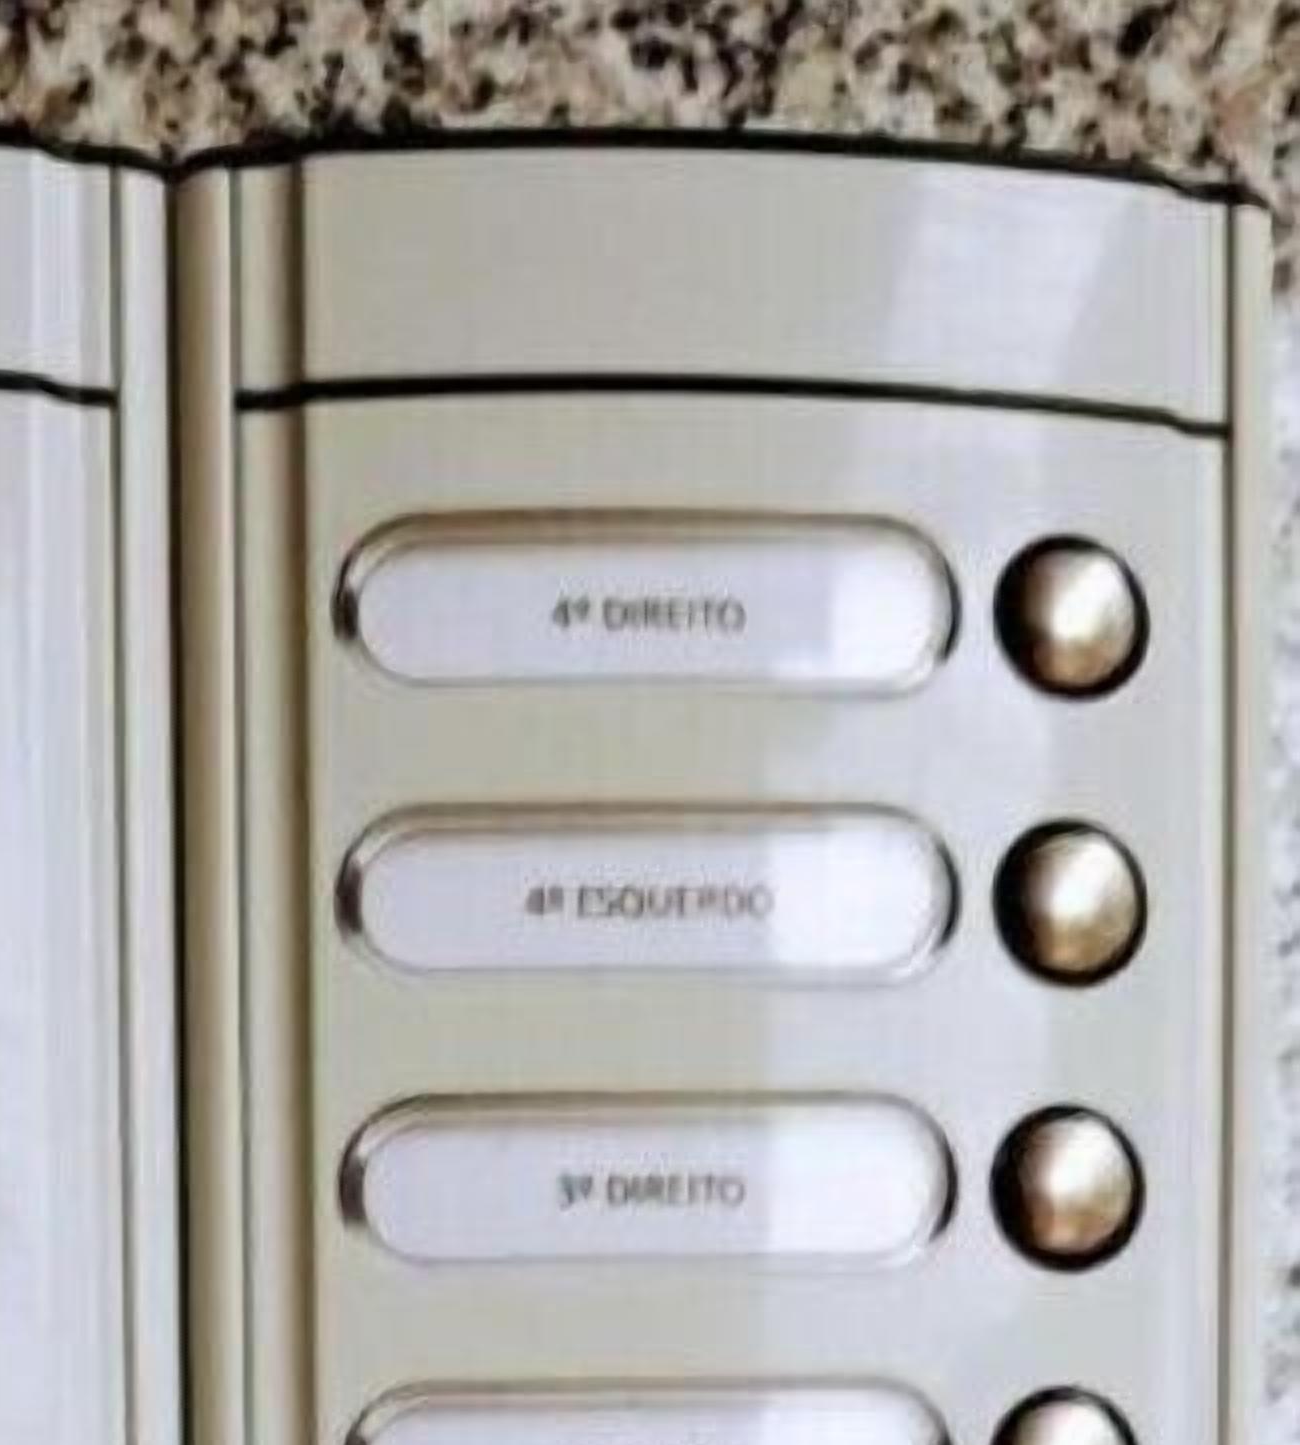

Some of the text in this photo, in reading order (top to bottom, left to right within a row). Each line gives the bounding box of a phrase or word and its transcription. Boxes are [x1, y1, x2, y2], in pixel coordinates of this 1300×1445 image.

[603, 595, 747, 632] DIREITO
[577, 883, 776, 920] ESQUERDO
[607, 1172, 747, 1208] DIREITO
